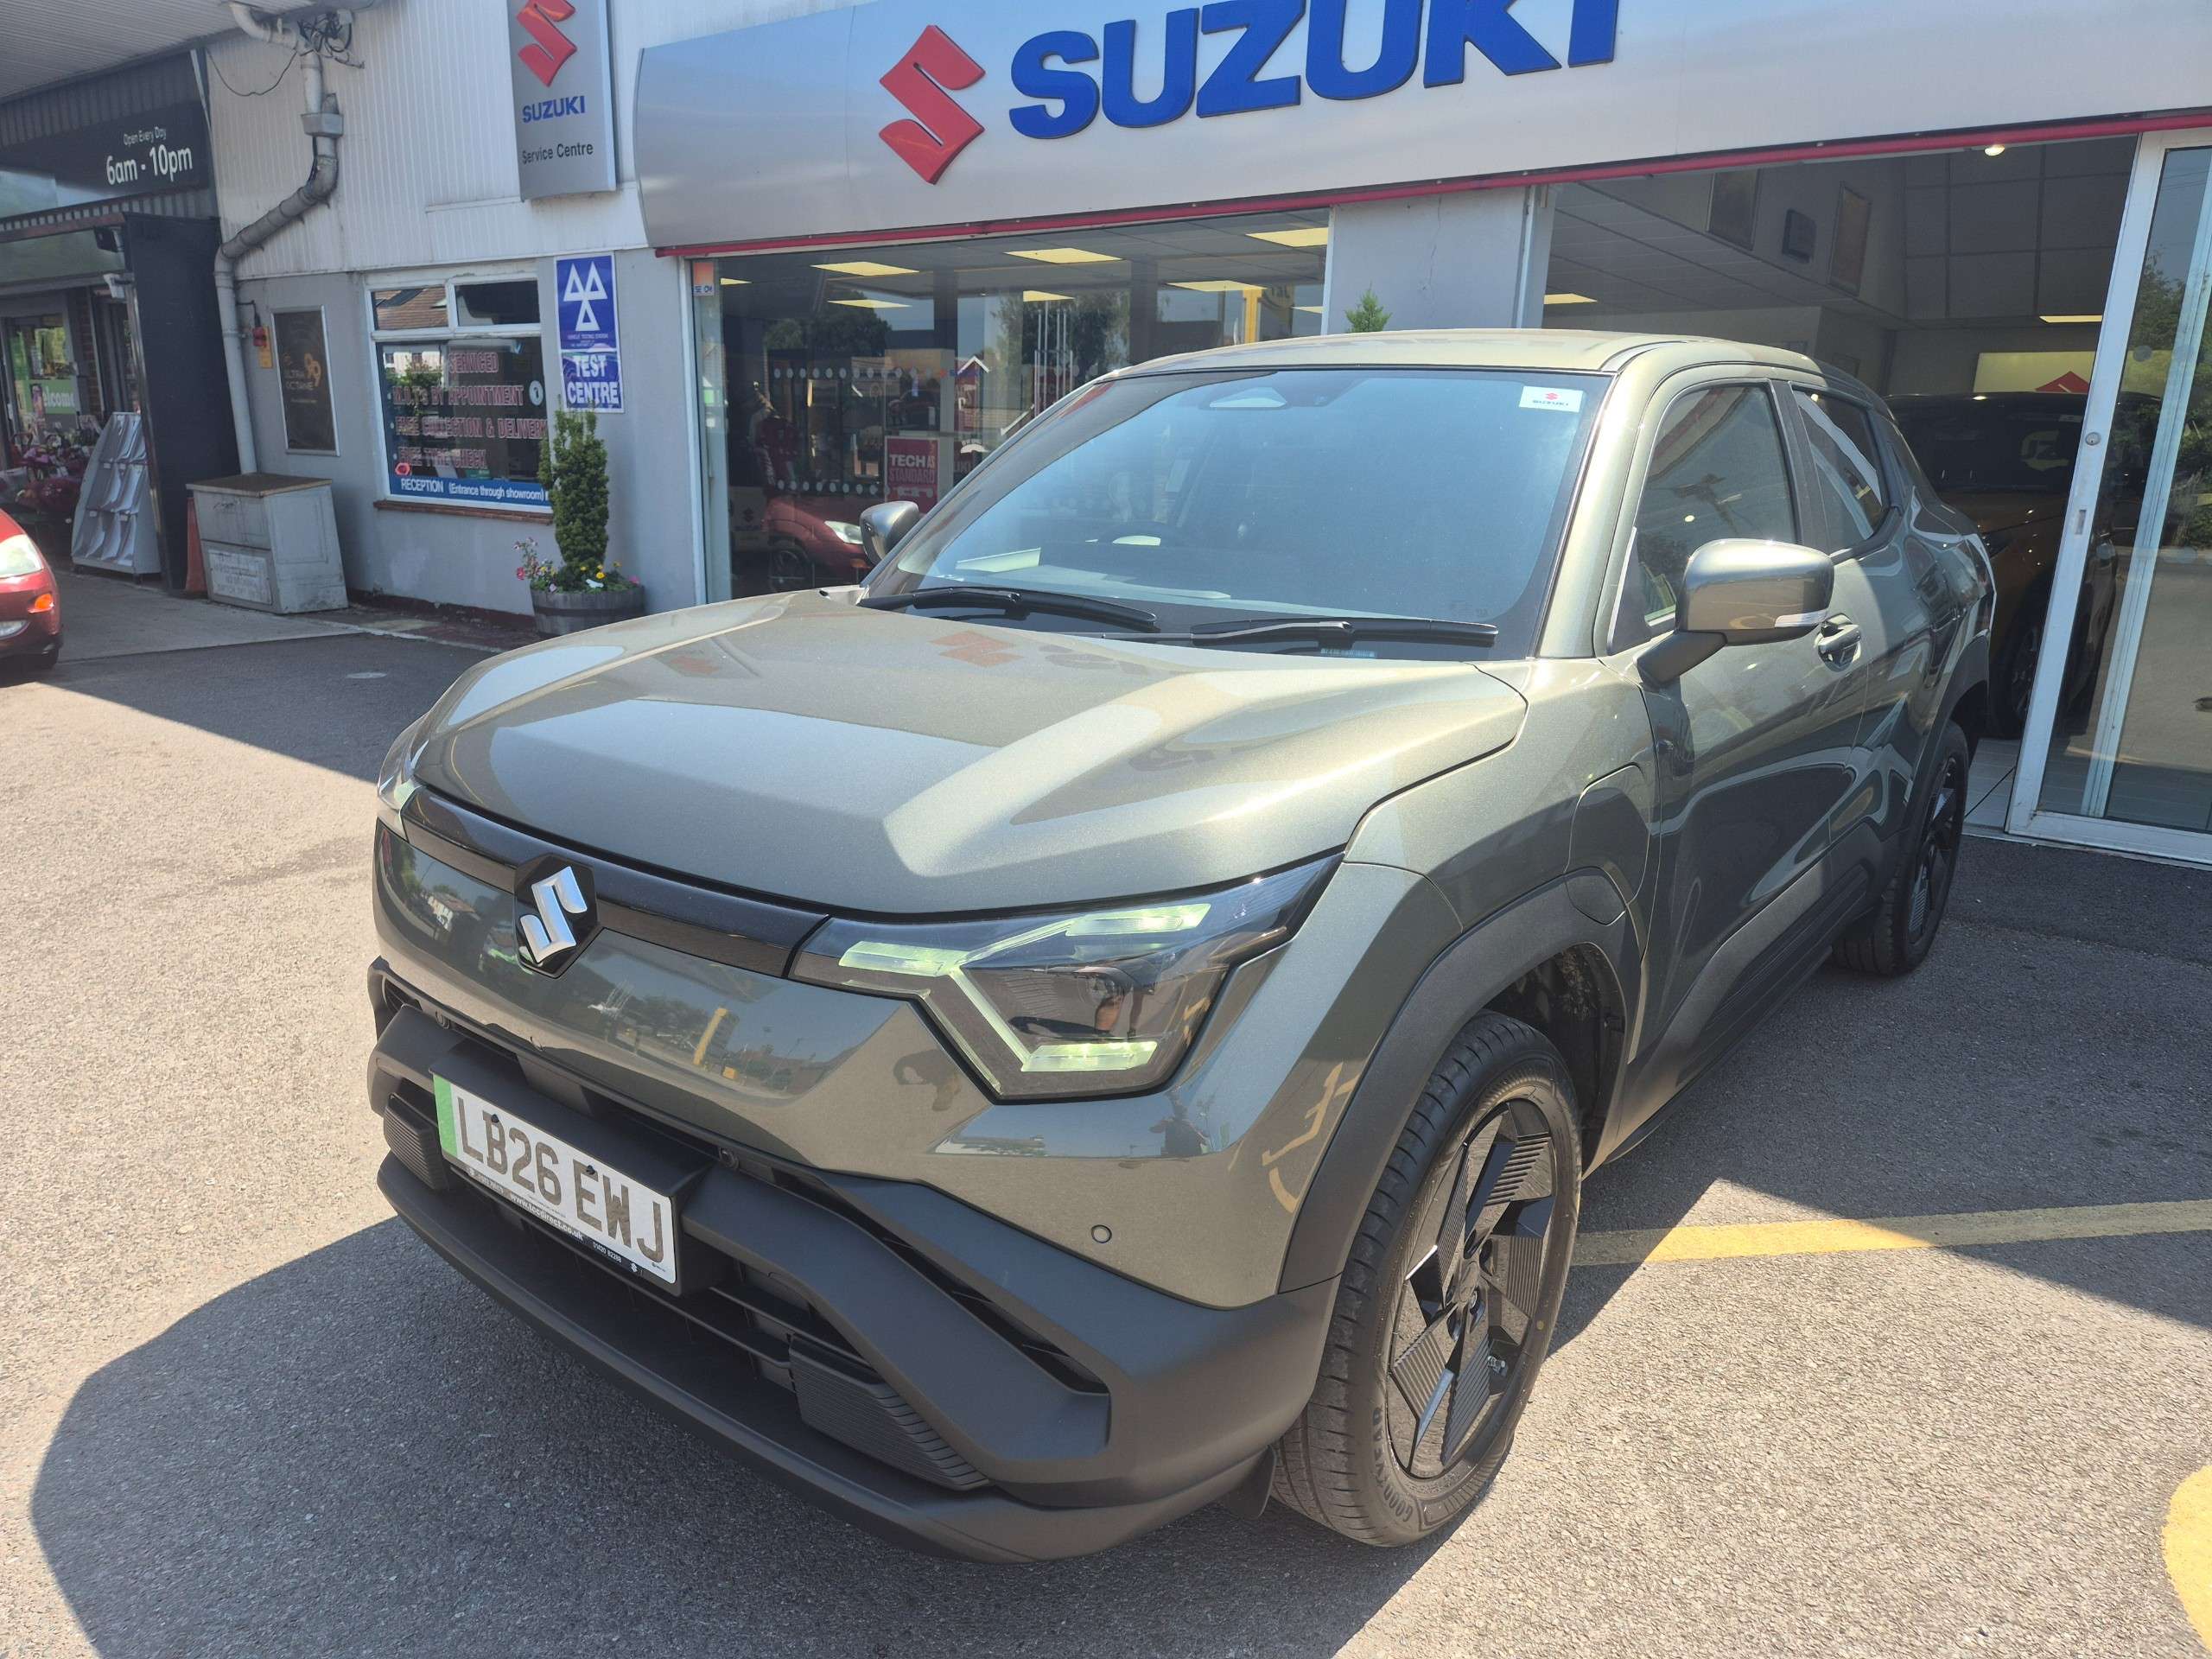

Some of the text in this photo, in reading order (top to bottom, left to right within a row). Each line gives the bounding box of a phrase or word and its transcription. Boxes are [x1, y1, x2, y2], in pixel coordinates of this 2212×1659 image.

[1008, 0, 1618, 140] SUZUKI
[522, 95, 586, 123] SUZUKI
[106, 156, 138, 186] 6am
[149, 144, 193, 182] 10pm
[522, 142, 594, 165] Service Centre
[448, 352, 499, 373] SERVICED
[573, 355, 607, 378] TEST
[448, 385, 524, 406] APPOINTMENT
[568, 381, 620, 404] CENTRE
[395, 416, 420, 435] FREE
[422, 416, 483, 437] COLLECTION
[486, 418, 495, 438] &
[889, 454, 937, 469] TECH AS
[889, 467, 936, 484] STANDARD
[401, 478, 543, 501] RECEPTION (Entrance through showroom)
[457, 1097, 664, 1263] LB26 EWJ
